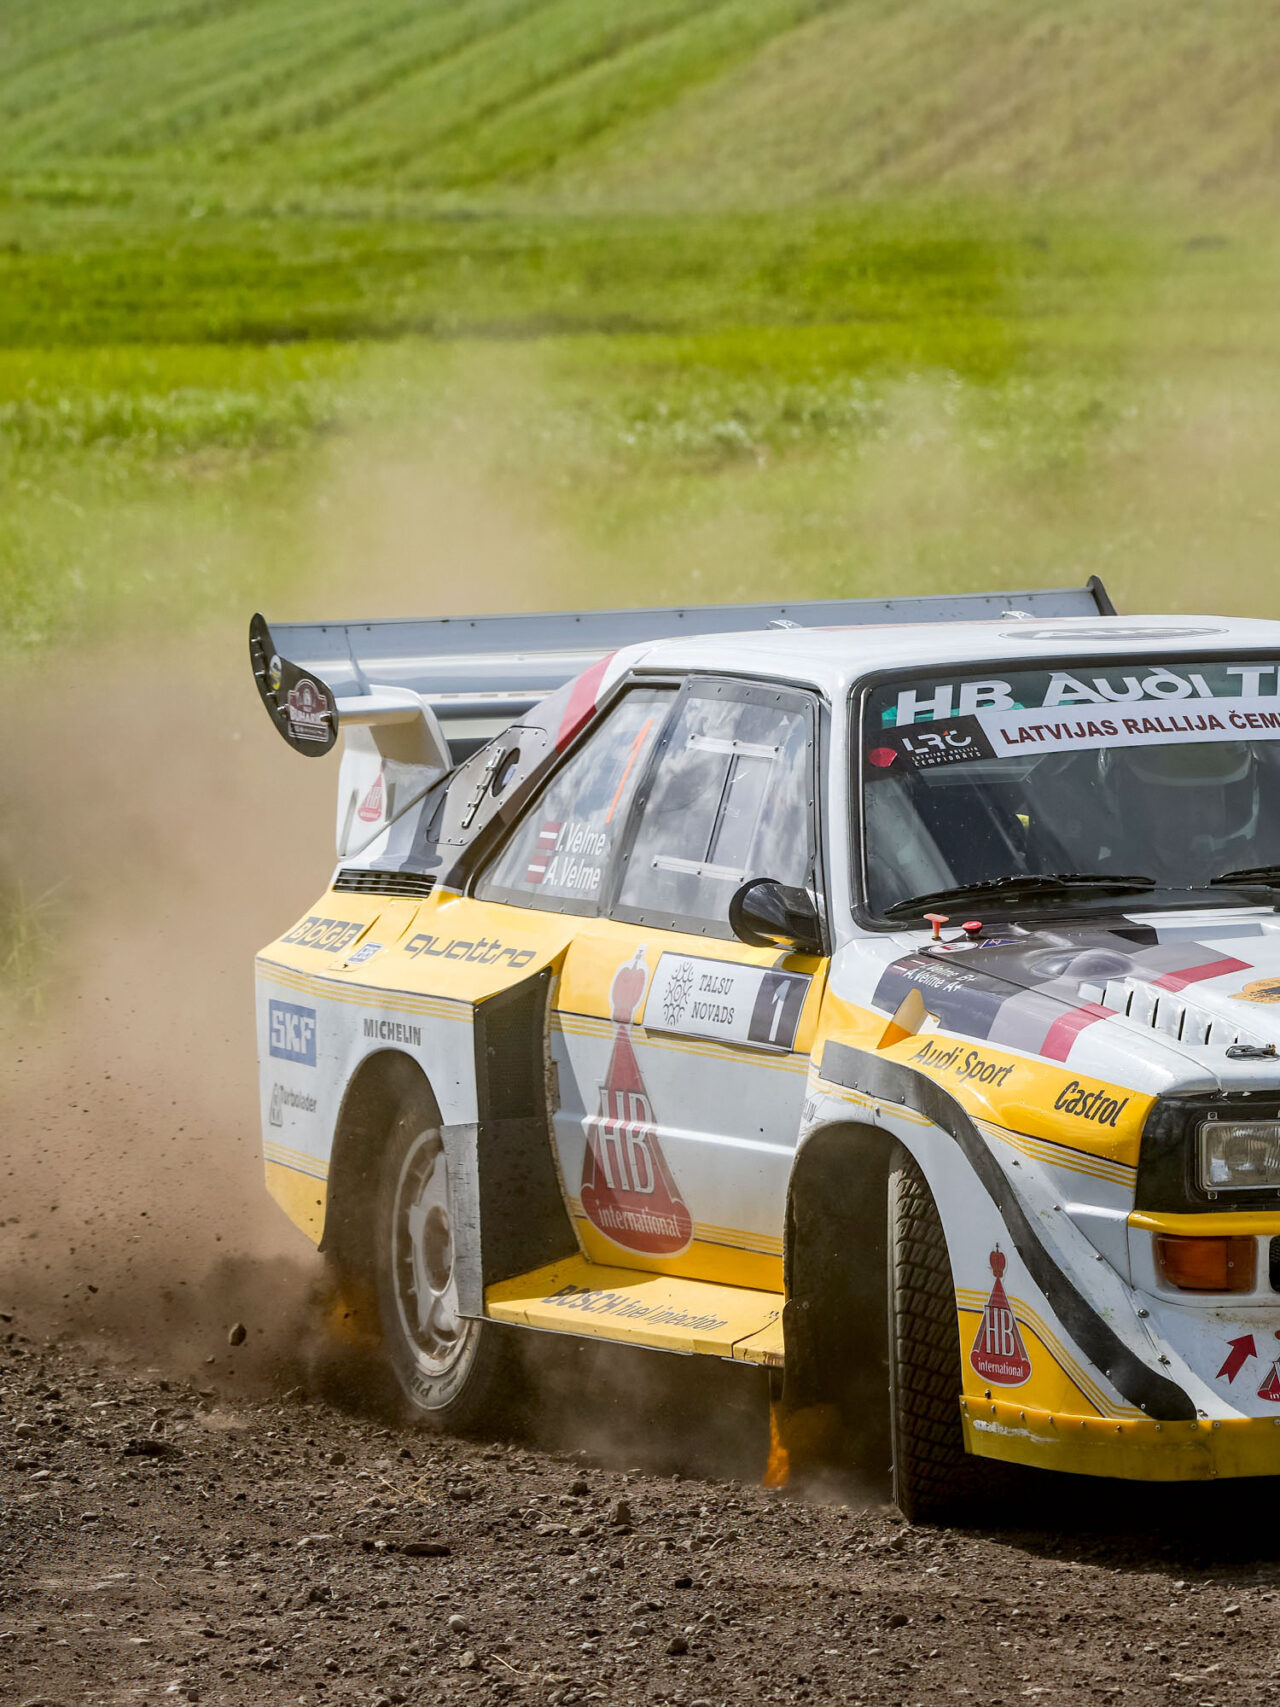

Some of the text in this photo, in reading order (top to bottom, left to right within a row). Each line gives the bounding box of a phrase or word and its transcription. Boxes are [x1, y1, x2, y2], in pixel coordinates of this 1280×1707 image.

[896, 680, 1014, 726] HB
[902, 730, 972, 754] LRC
[1000, 719, 1118, 744] LATVIJAS
[1121, 712, 1226, 735] RALLIJA
[282, 917, 364, 952] BOGE
[403, 934, 536, 968] quattro
[699, 974, 734, 996] TALSU
[691, 1002, 735, 1025] NOVADS
[771, 980, 791, 1042] 1
[271, 1010, 316, 1055] SKF
[363, 1018, 422, 1047] MICHELIN
[908, 1040, 1016, 1087] Audi Sport
[1054, 1080, 1130, 1128] Castrol
[599, 1088, 656, 1194] HB
[595, 1200, 682, 1238] international
[542, 1284, 630, 1313] BOSCH
[610, 1300, 664, 1318] fuel
[985, 1305, 1015, 1357] HB
[978, 1357, 1024, 1377] international
